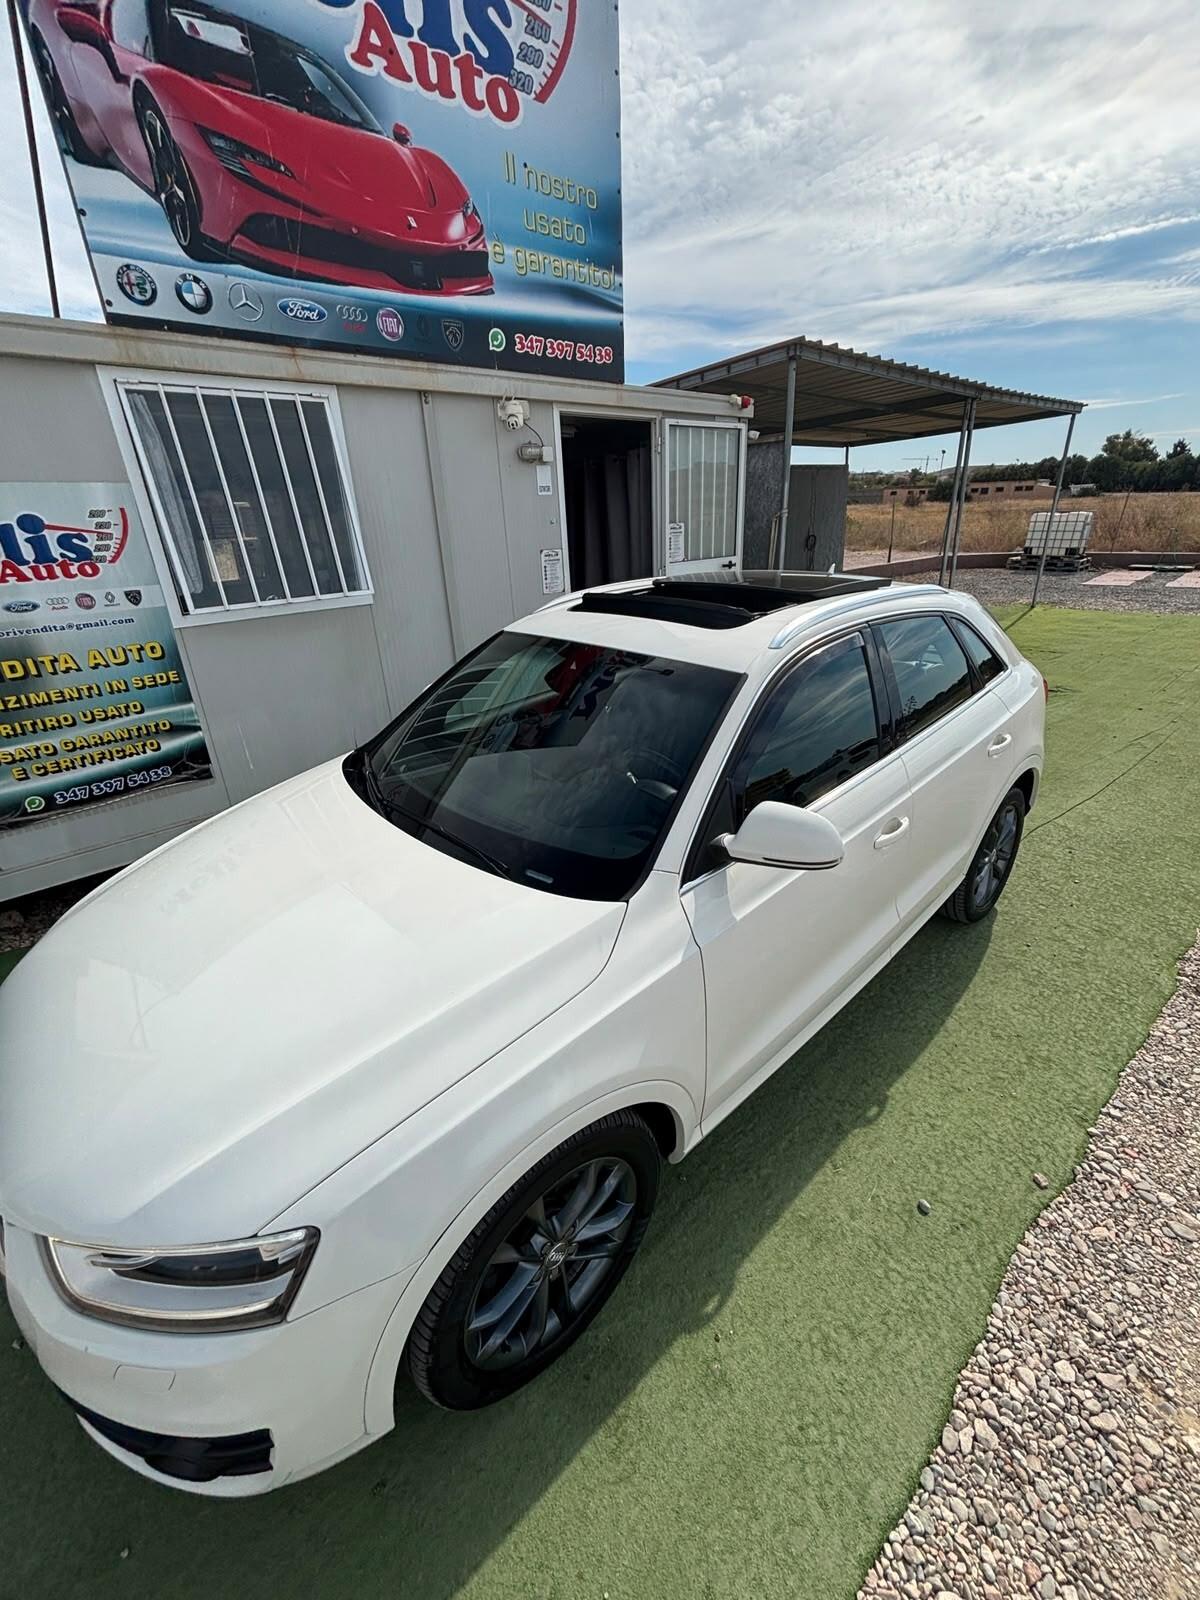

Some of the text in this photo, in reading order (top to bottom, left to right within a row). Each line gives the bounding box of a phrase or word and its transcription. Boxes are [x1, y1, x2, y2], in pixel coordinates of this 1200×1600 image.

[525, 13, 551, 43] 260
[351, 2, 520, 122] Auto
[516, 42, 544, 69] 290
[508, 68, 534, 95] 320
[504, 151, 597, 209] Il nostro
[524, 208, 586, 245] usato
[492, 232, 616, 291] è garantito!
[286, 300, 319, 320] Ford
[382, 317, 398, 333] FIAT
[514, 333, 544, 356] 347
[546, 338, 574, 360] 397
[0, 559, 100, 583] Auto
[10, 601, 33, 611] Ford
[88, 641, 164, 668] AUTO
[104, 679, 128, 693] IN
[131, 670, 180, 688] SEDE
[0, 701, 142, 737] RITIRO USATO
[60, 719, 171, 751] GARANTITO
[11, 738, 159, 780] E CERTIFICATO
[54, 786, 89, 804] 347
[91, 777, 124, 796] 397
